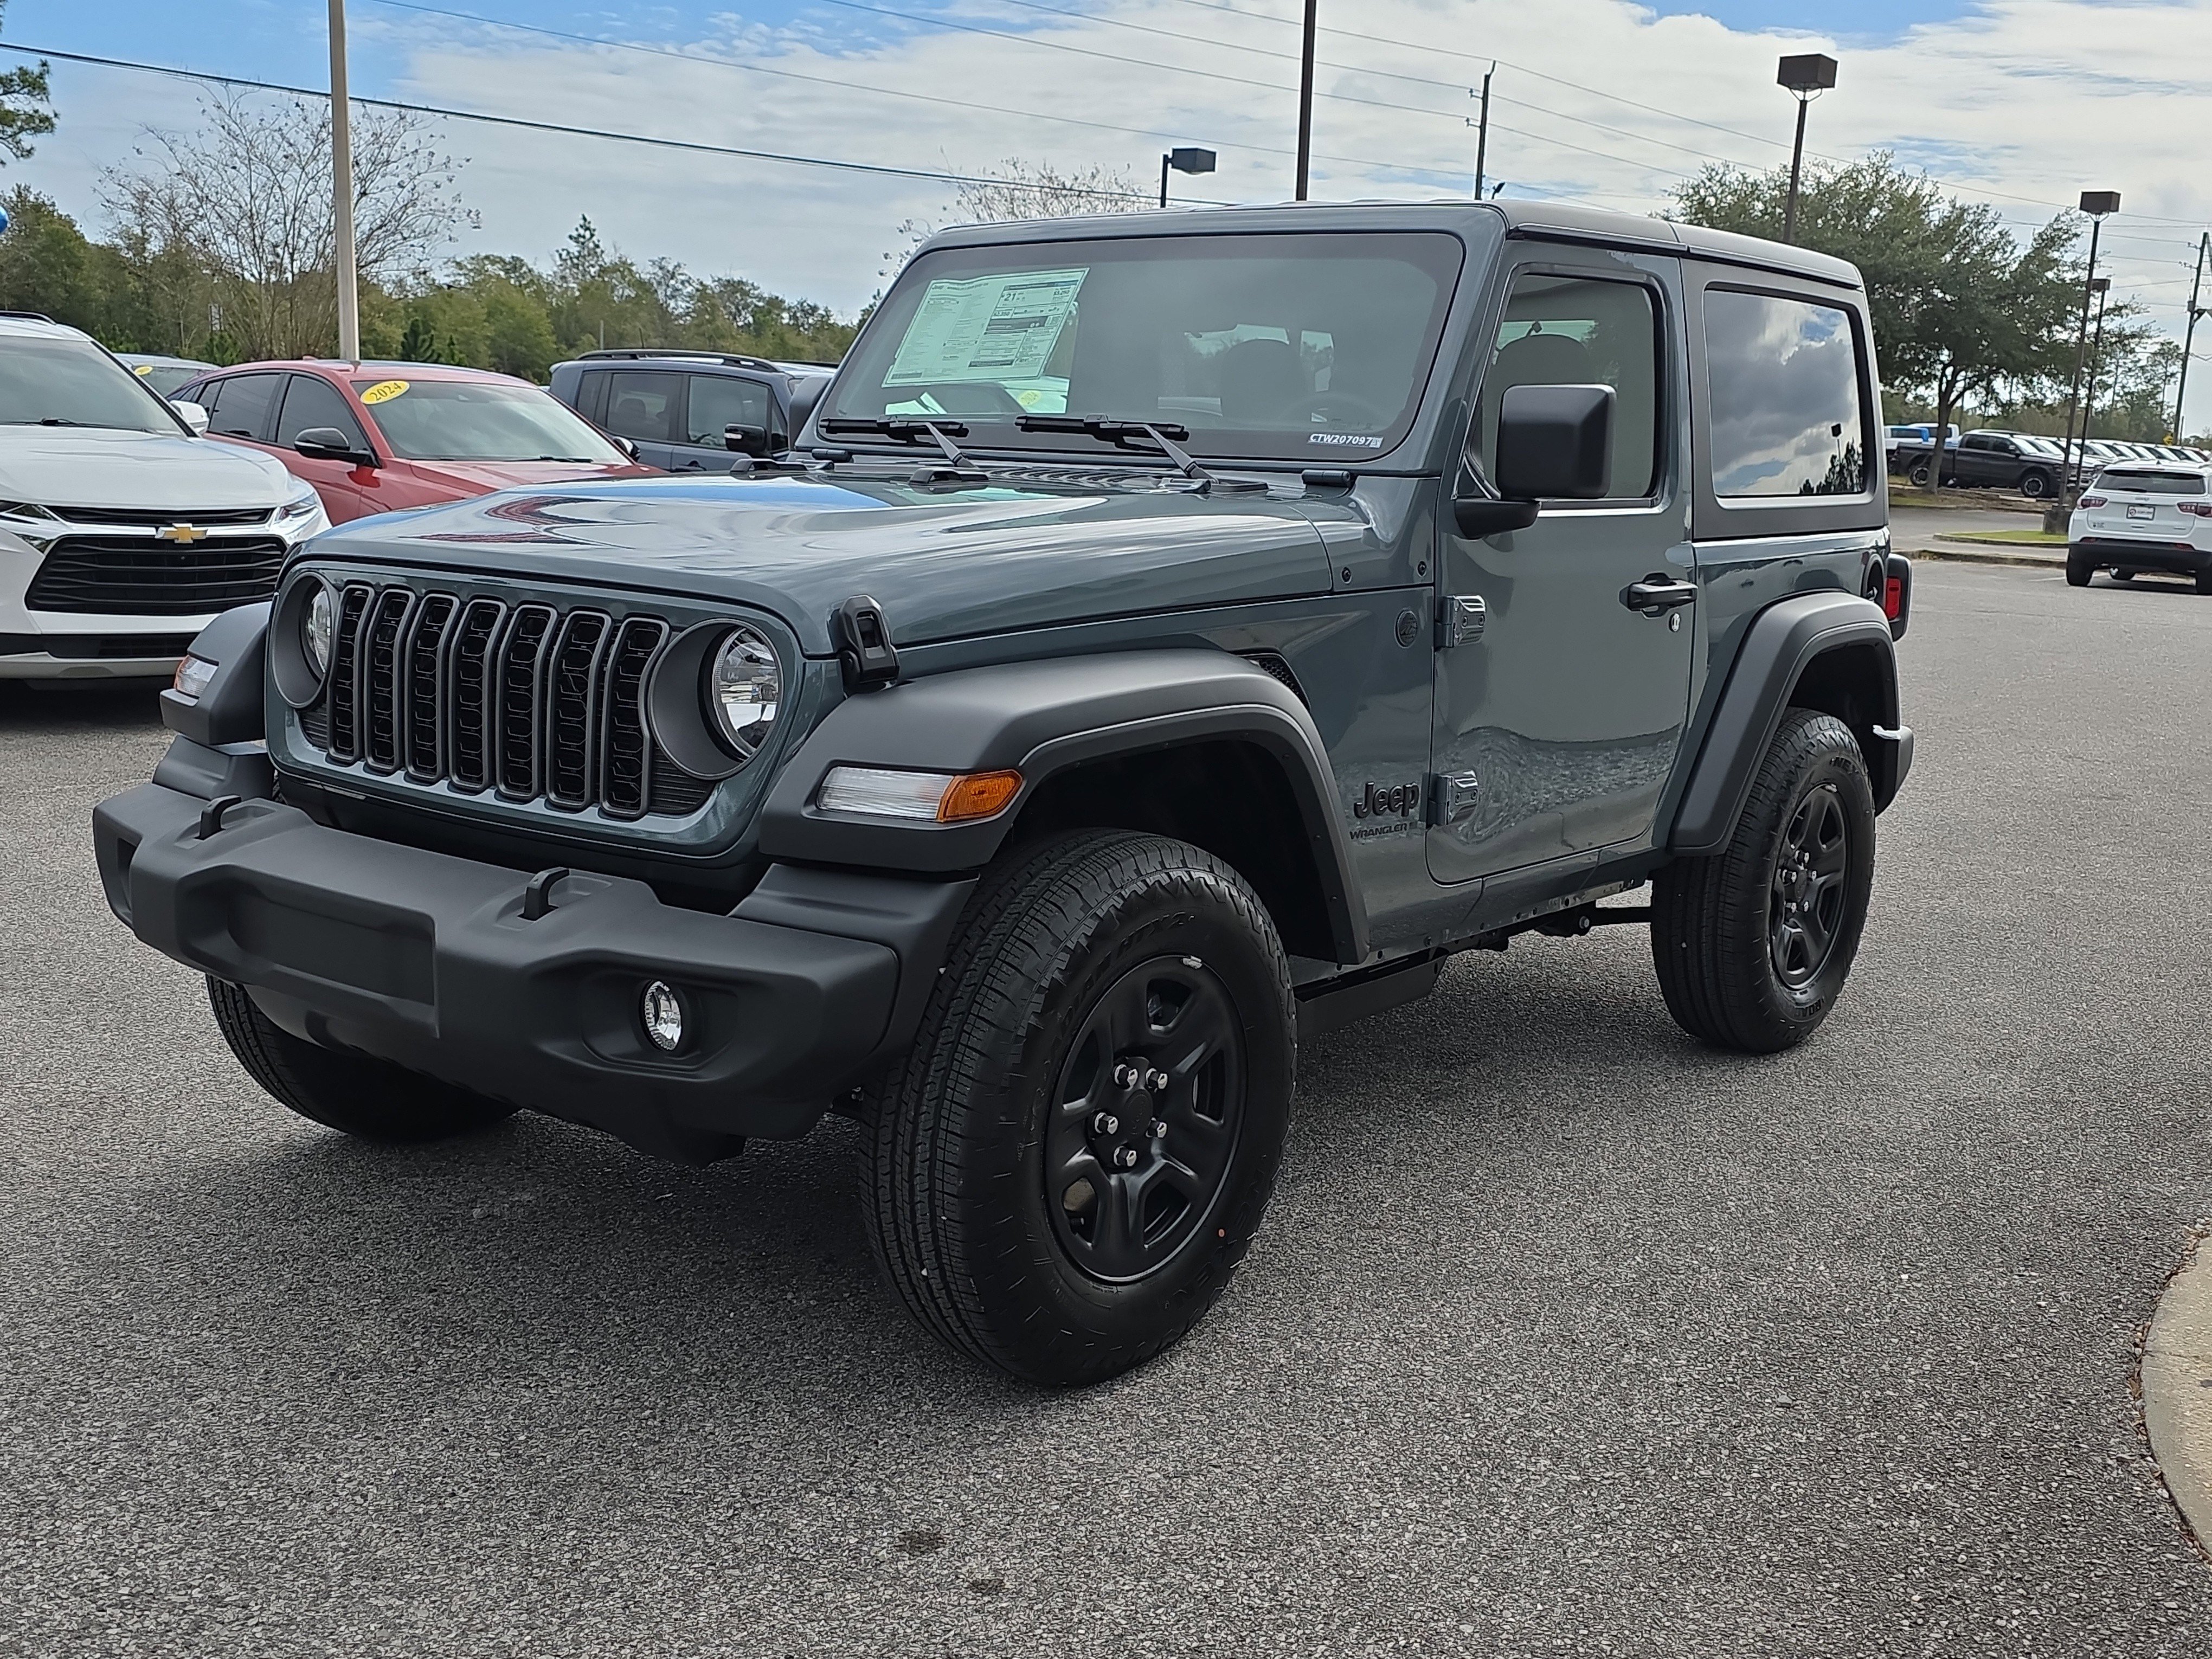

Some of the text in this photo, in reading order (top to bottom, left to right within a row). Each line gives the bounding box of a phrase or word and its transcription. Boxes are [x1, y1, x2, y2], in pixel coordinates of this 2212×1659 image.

[1004, 293, 1017, 301] 21
[370, 382, 402, 401] 2024
[1310, 433, 1373, 445] CTW207097
[1353, 781, 1419, 819] Jeep
[1349, 822, 1407, 840] WRANGLER
